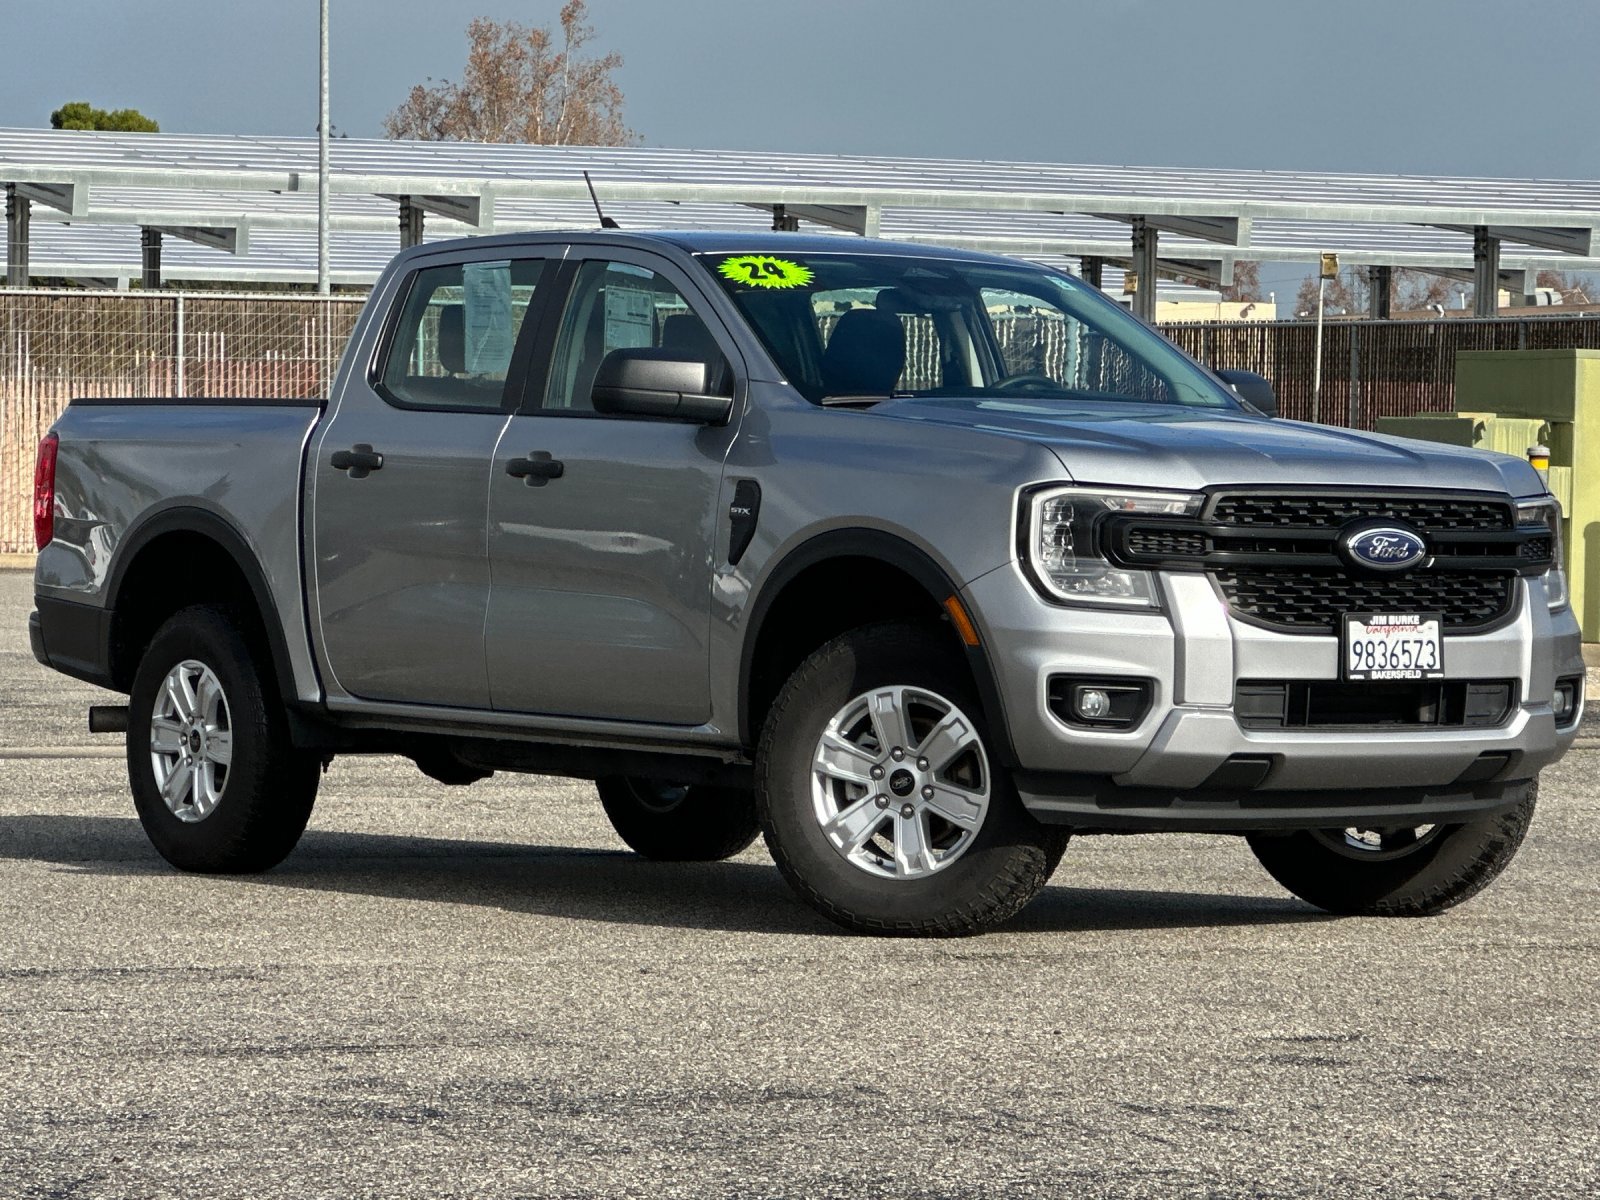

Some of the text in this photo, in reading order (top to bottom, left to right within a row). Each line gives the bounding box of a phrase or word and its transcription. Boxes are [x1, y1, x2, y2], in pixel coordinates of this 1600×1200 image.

[730, 507, 751, 516] STX
[1369, 536, 1409, 558] Ford
[1370, 615, 1420, 625] JIM BURKE
[1352, 640, 1437, 670] 98365Z3
[1371, 670, 1422, 679] BAKERSFIELD
